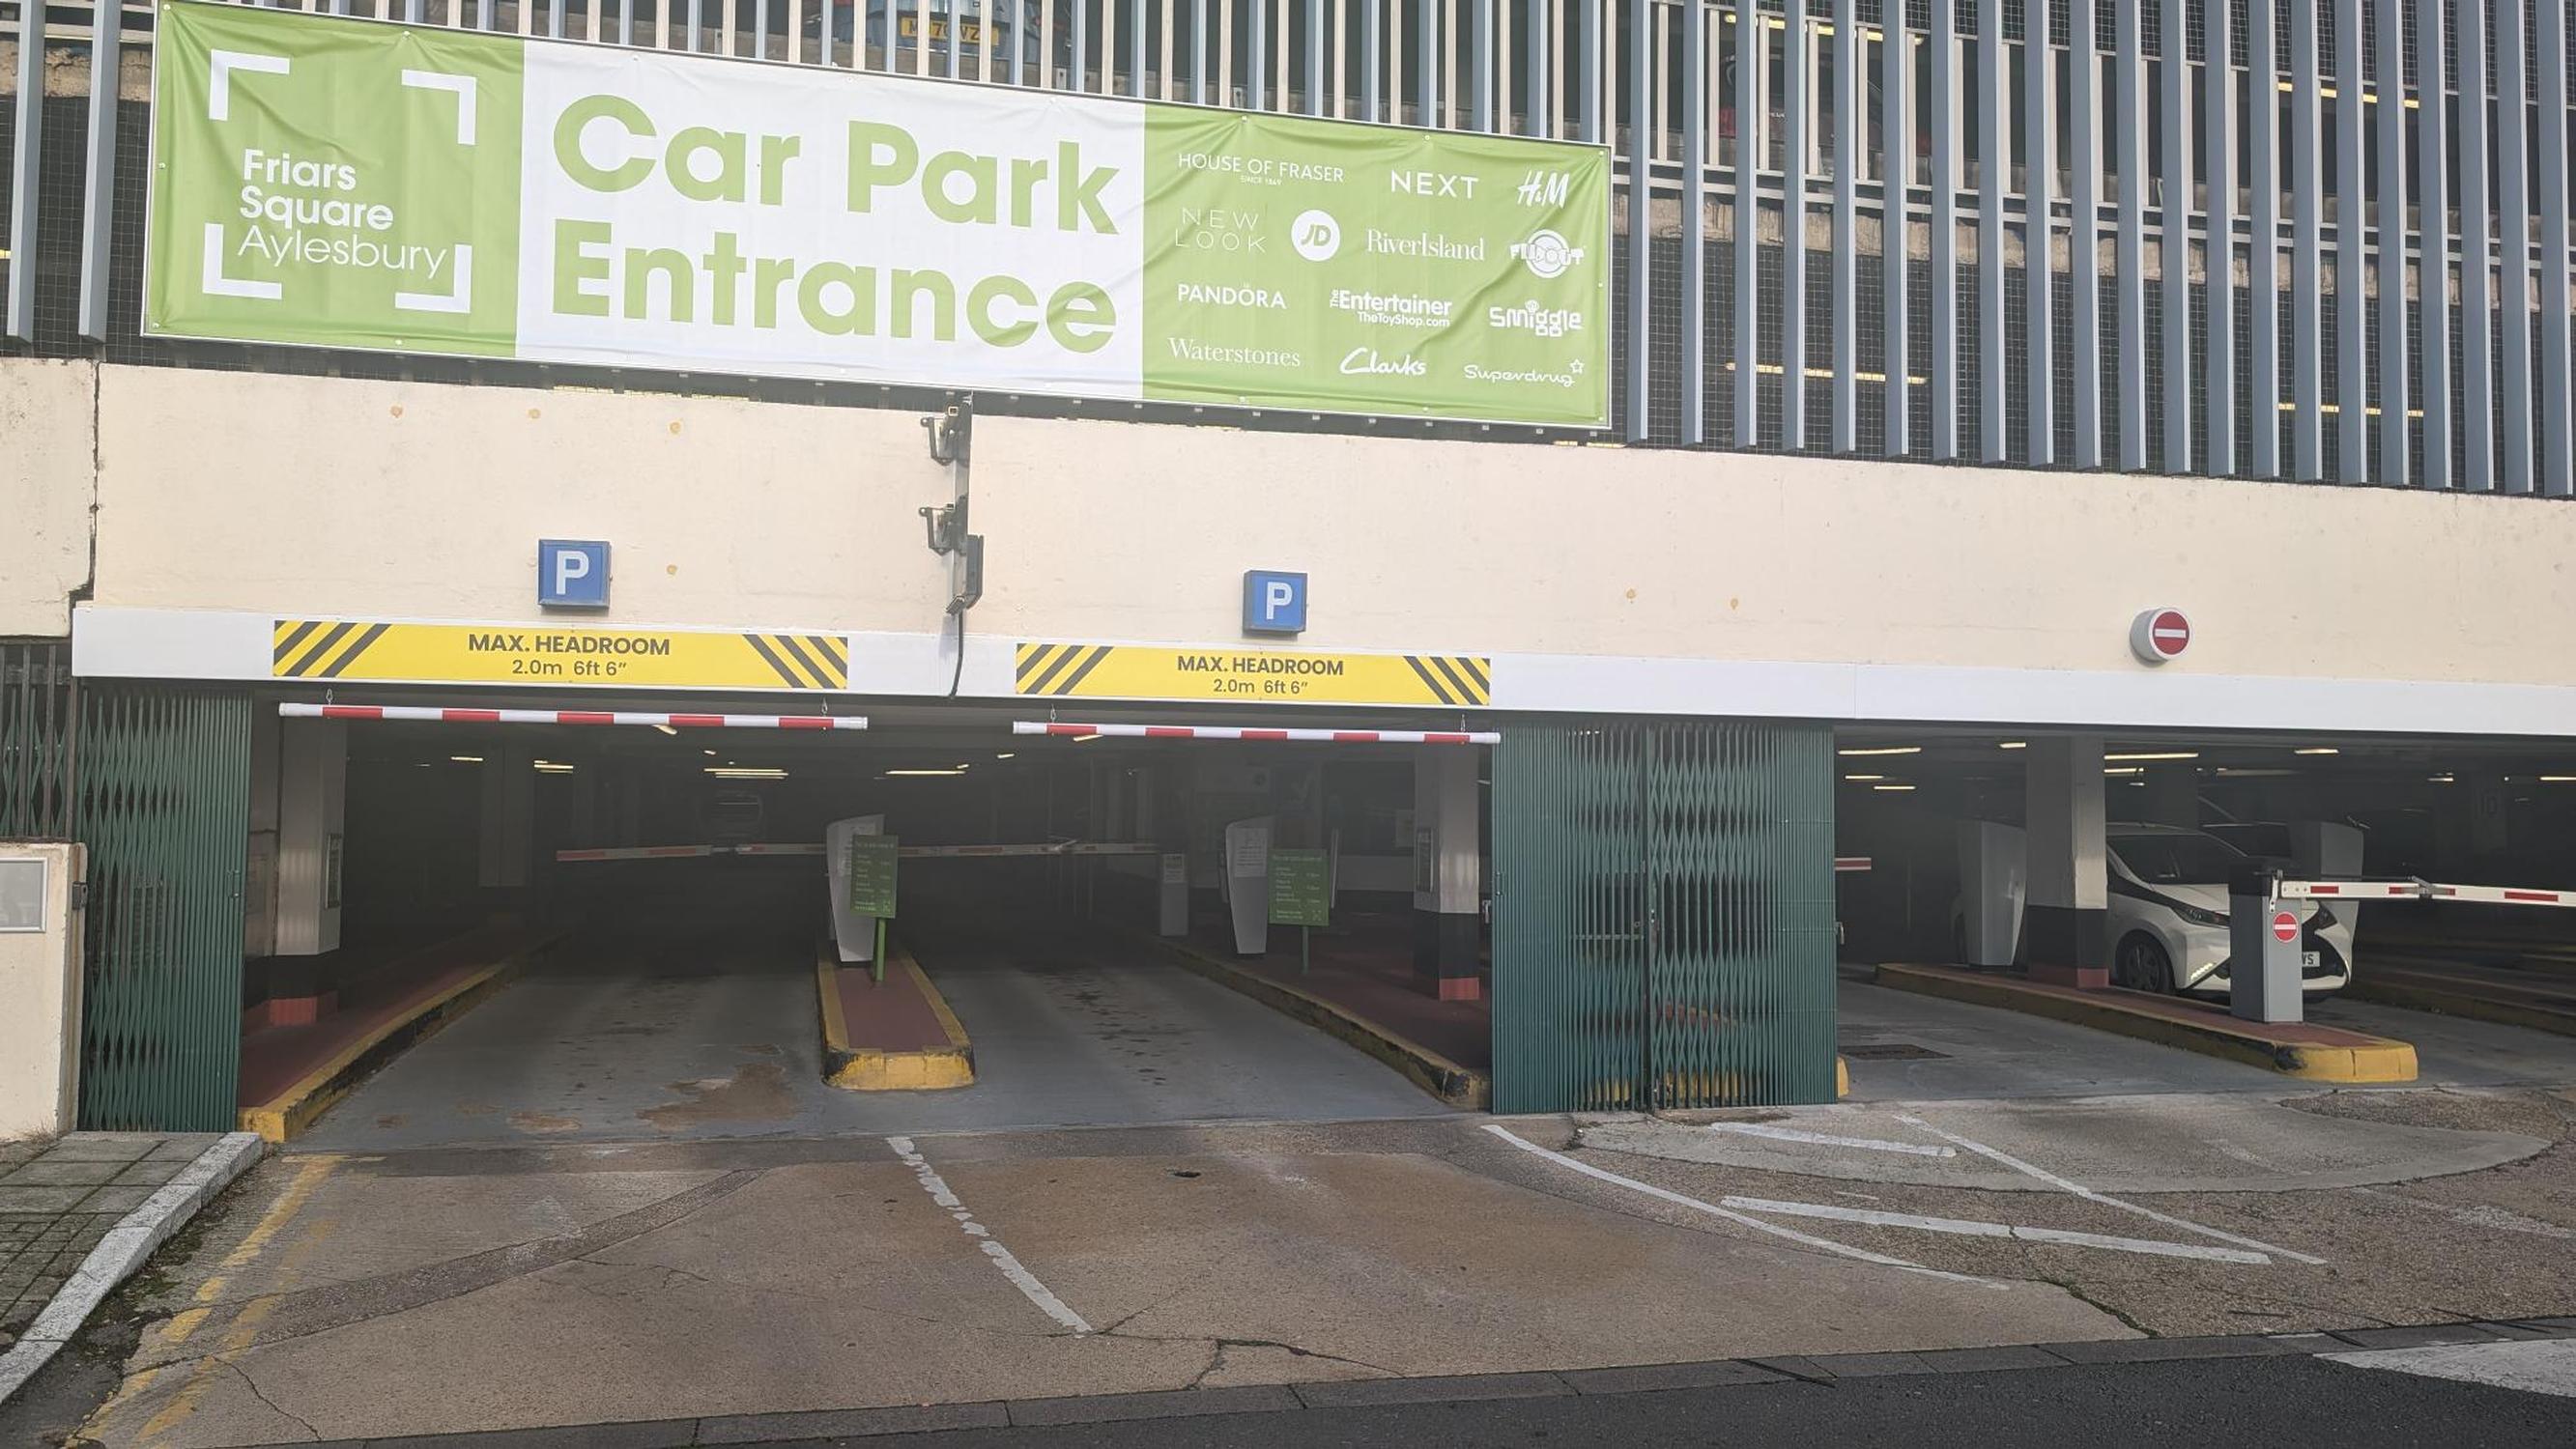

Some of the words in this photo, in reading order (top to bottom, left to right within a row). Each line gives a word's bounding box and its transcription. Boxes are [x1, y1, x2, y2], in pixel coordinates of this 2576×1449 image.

[243, 148, 357, 190] Friars
[553, 94, 800, 206] Car
[846, 120, 1120, 235] Park
[1178, 153, 1243, 172] HOUSE
[1247, 158, 1274, 175] OF
[1279, 161, 1344, 183] FRASER
[1390, 170, 1479, 199] NEXT
[1517, 170, 1570, 209] H&M
[240, 185, 394, 230] Square
[1182, 207, 1259, 231] NEW
[1175, 228, 1268, 253] LOOK
[1301, 223, 1331, 246] JD
[238, 224, 447, 279] Aylesbury
[553, 217, 1117, 354] Entrance
[1177, 283, 1287, 309] PANDORA
[1330, 289, 1339, 308] The
[1339, 290, 1452, 316] Entertainer
[1358, 311, 1450, 328] TheToyShop.com
[1168, 337, 1301, 367] Waterstones
[1339, 347, 1427, 376] Clarks
[1463, 364, 1576, 388] Superdrug
[555, 550, 589, 596] P
[1266, 581, 1294, 620] P
[468, 633, 530, 652] MAX.
[534, 635, 671, 656] HEADROOM
[511, 659, 562, 675] 2.0m
[573, 660, 600, 676] 6ft
[1177, 655, 1228, 672] MAX.
[1232, 657, 1344, 676] HEADROOM
[1213, 678, 1255, 694] 2.0m
[1264, 679, 1286, 694] 6ft
